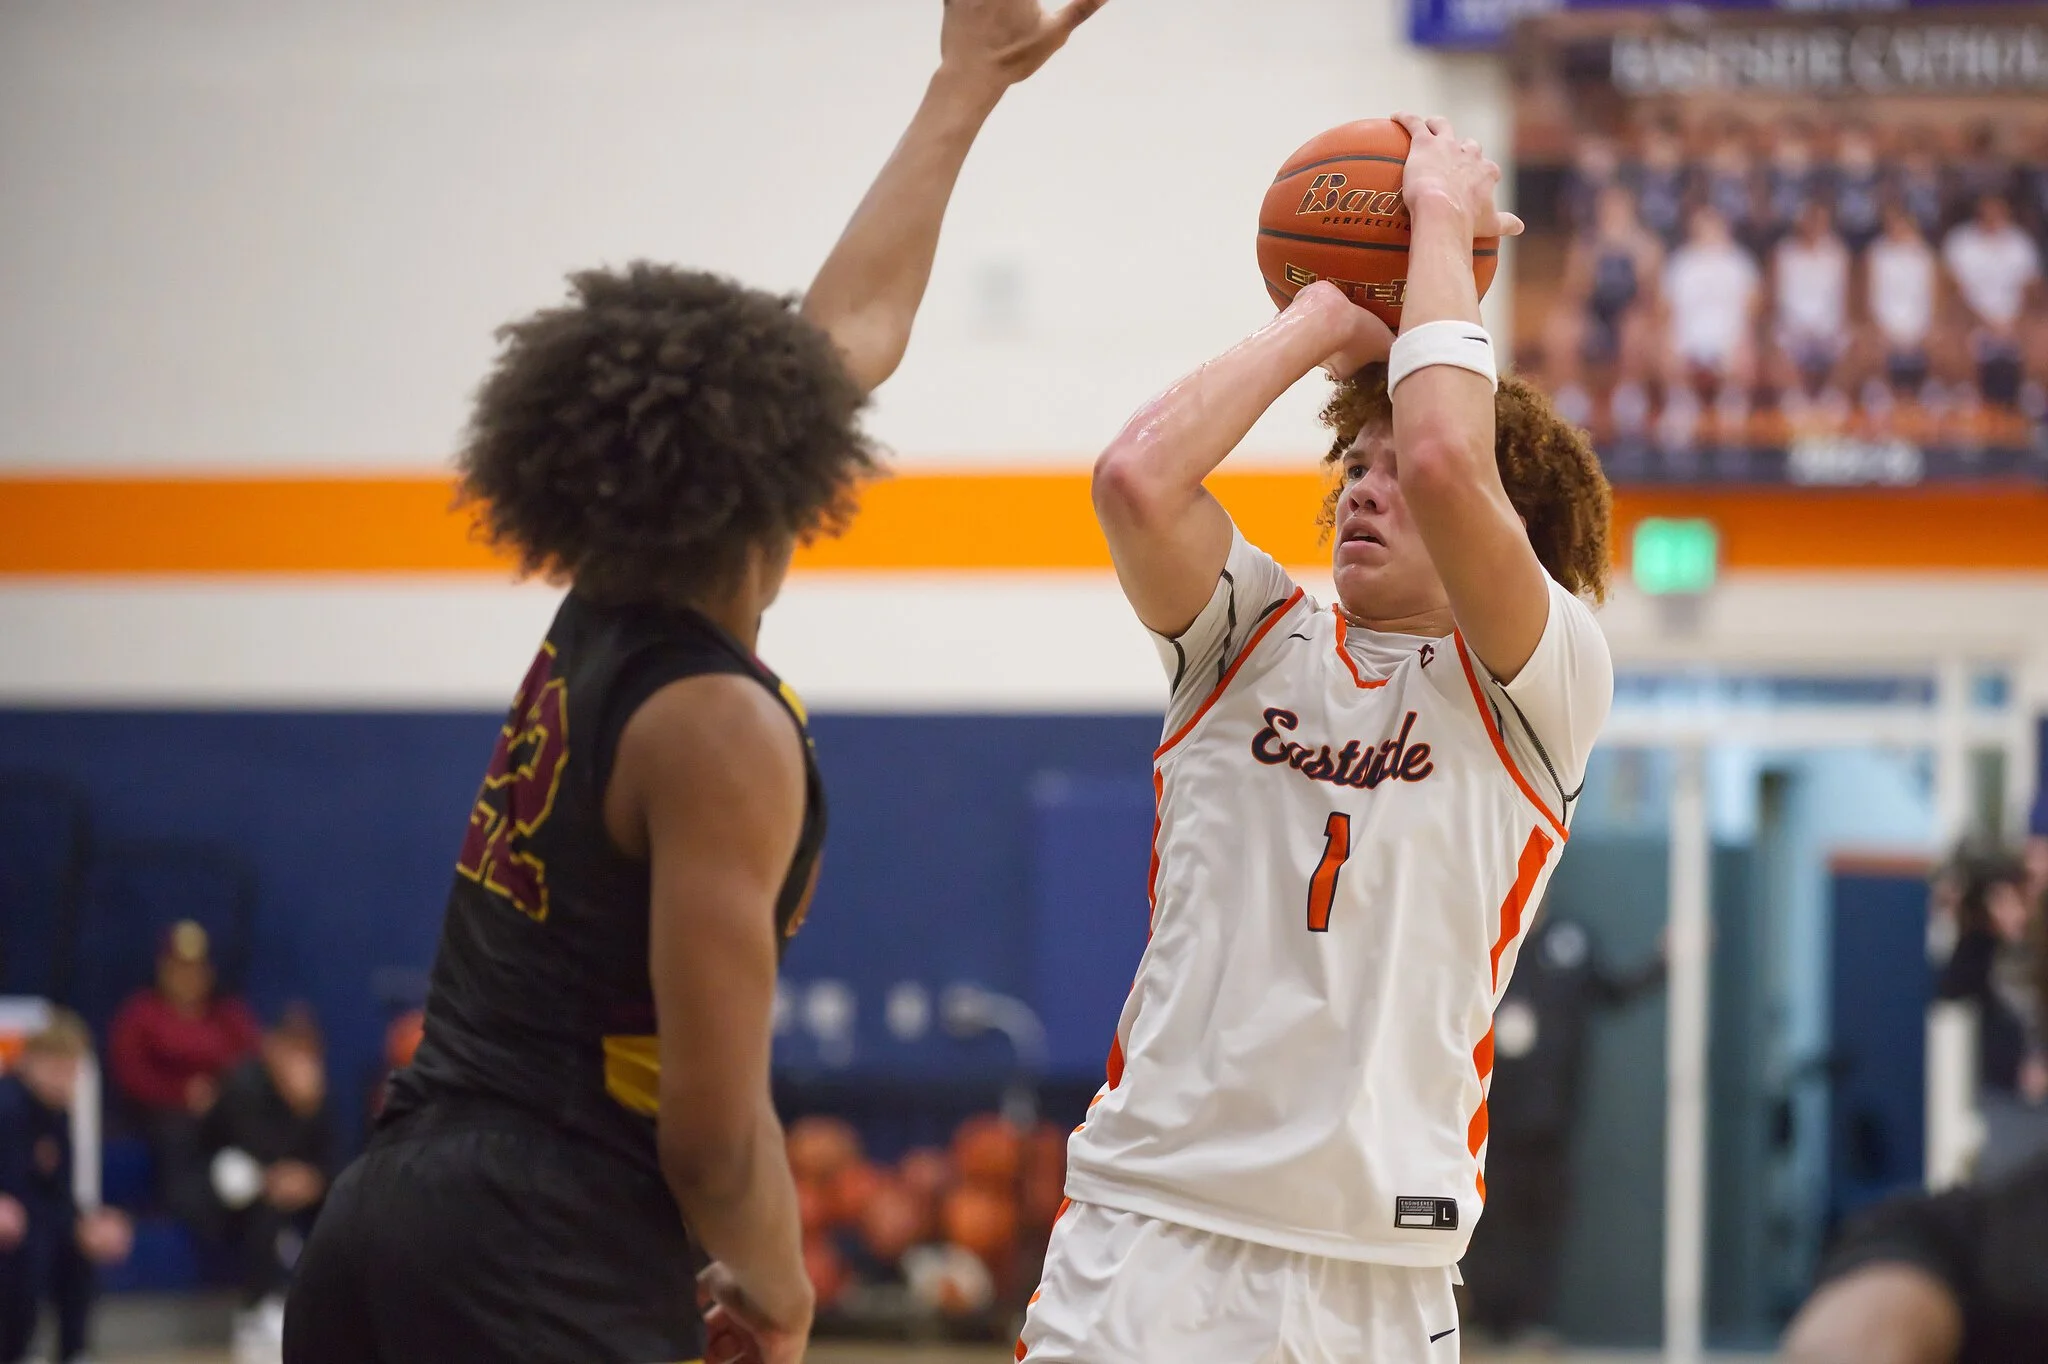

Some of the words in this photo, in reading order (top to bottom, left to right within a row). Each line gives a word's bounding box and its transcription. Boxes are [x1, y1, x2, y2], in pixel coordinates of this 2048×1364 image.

[1295, 173, 1411, 216] Bad
[1322, 216, 1411, 232] PERFECTIO
[1251, 707, 1434, 790] Eastside
[1307, 811, 1351, 933] 1
[1442, 1207, 1450, 1221] L
